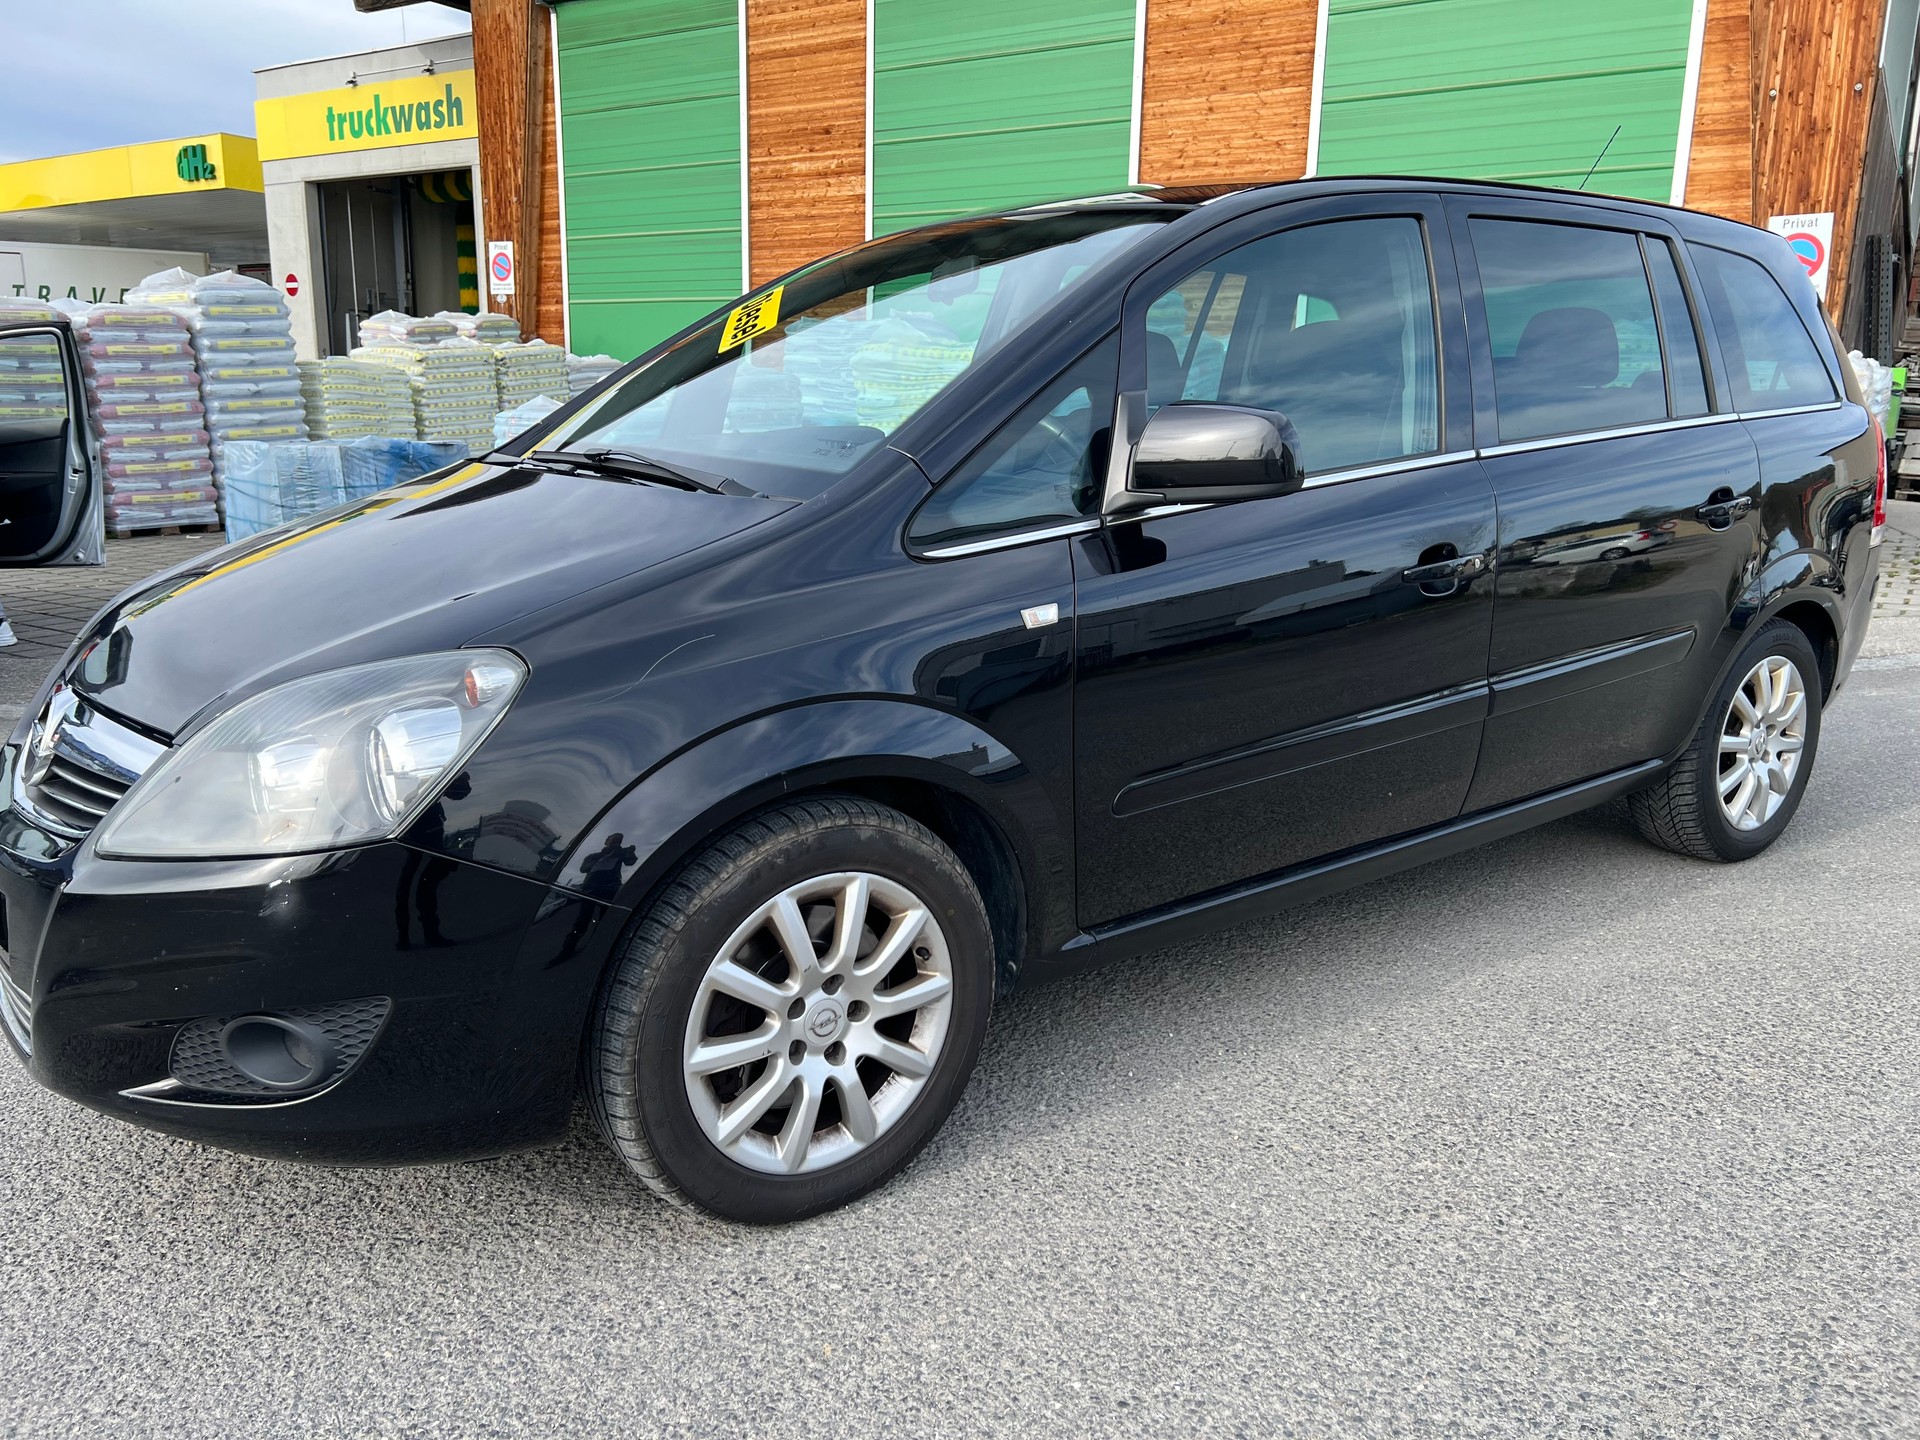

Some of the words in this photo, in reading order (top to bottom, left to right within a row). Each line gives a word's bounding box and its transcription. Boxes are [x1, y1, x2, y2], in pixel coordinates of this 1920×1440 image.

[326, 83, 463, 142] truckwash
[1782, 218, 1819, 229] Privat
[729, 291, 775, 346] Diesel
